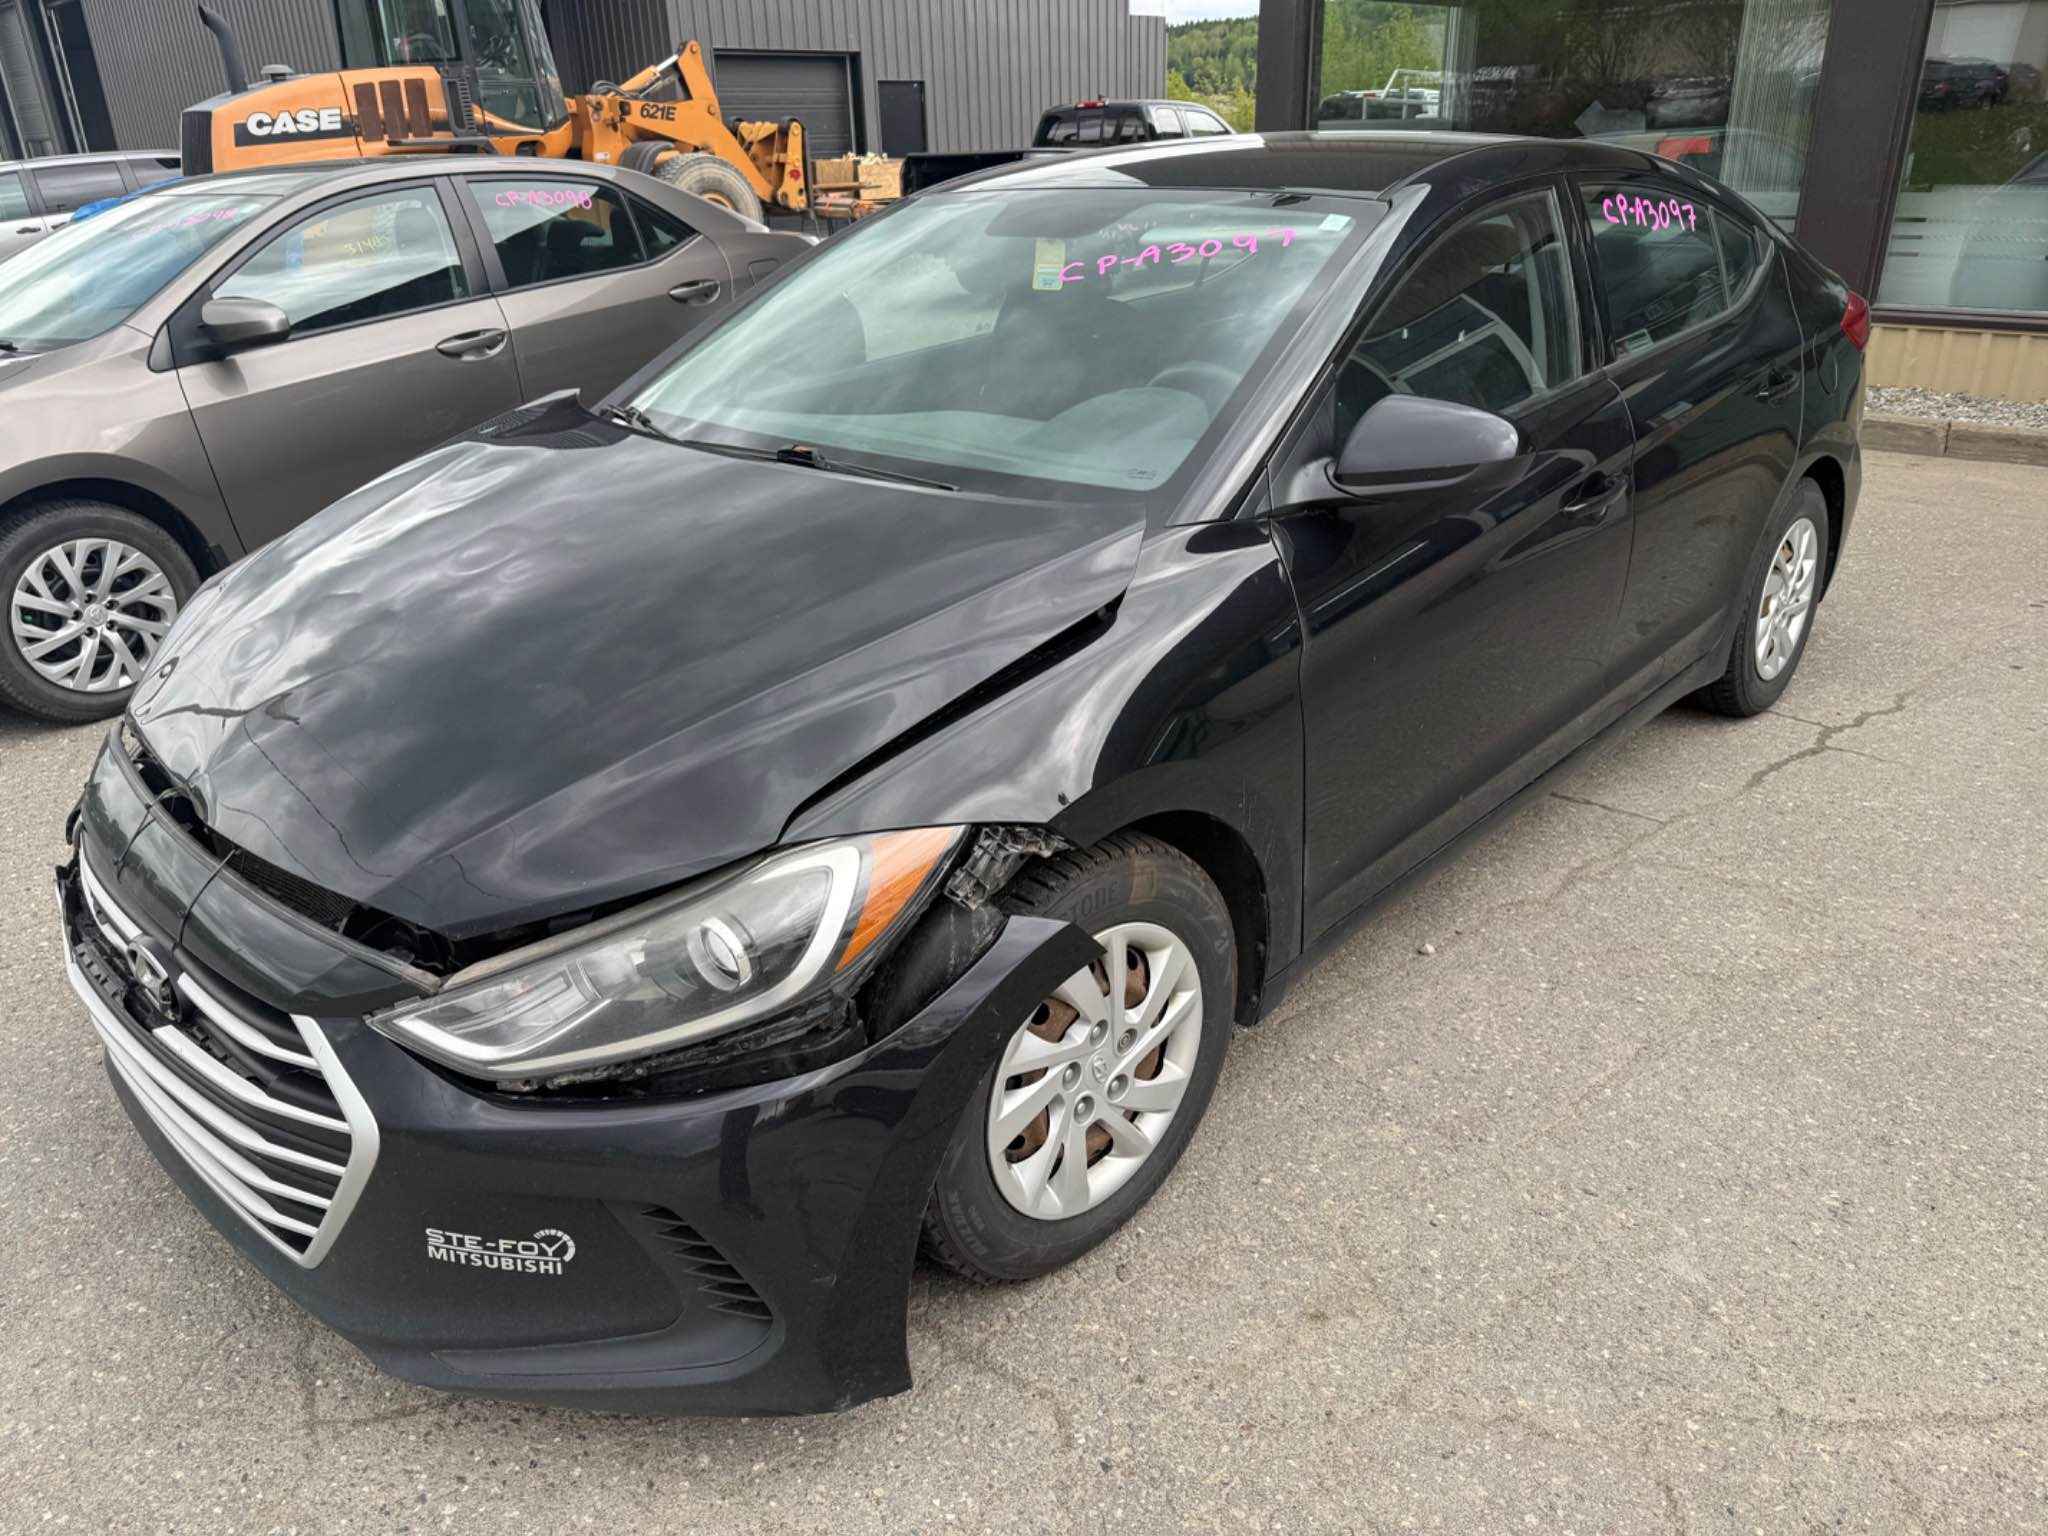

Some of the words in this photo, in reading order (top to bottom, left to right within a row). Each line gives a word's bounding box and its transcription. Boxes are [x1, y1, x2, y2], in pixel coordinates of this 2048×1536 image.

[247, 108, 341, 136] CASE
[641, 103, 677, 121] 621E
[1602, 193, 1696, 232] CP-A3097
[425, 1228, 566, 1257] STE-FOY
[428, 1245, 563, 1275] MITSUBISHI
